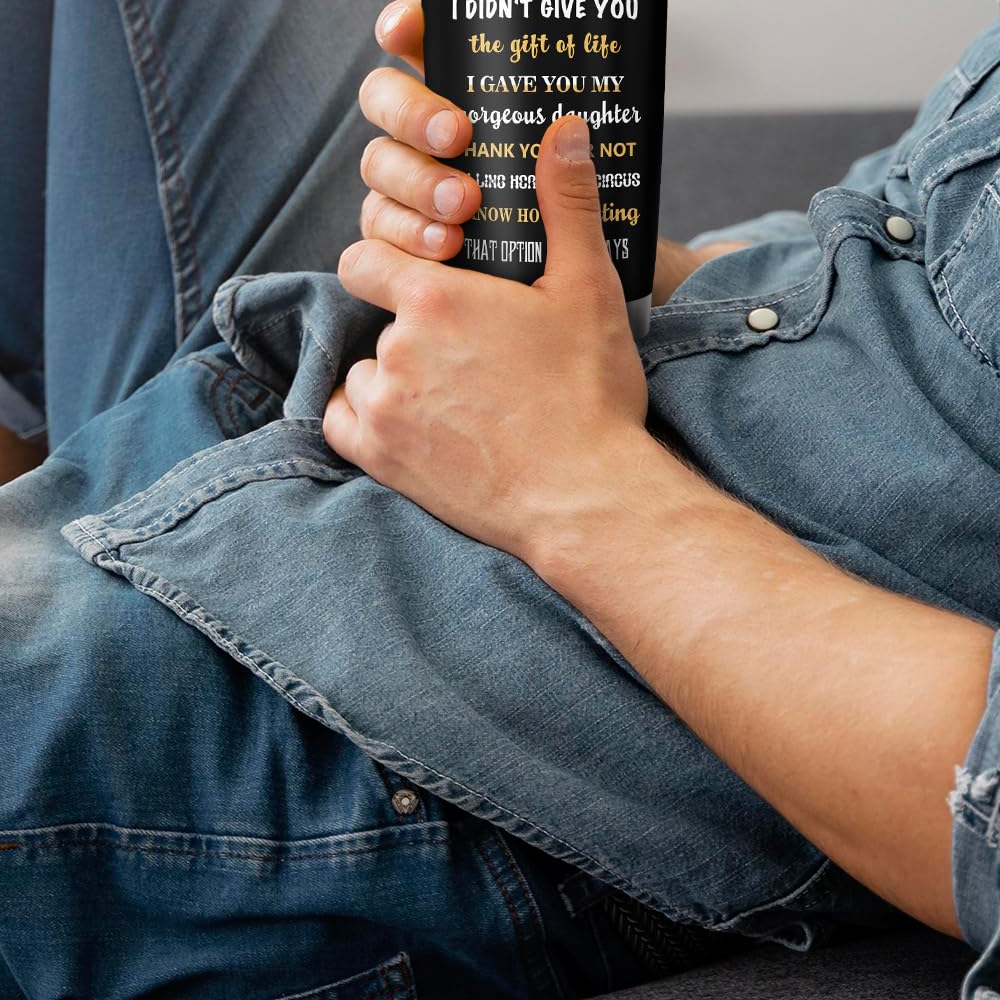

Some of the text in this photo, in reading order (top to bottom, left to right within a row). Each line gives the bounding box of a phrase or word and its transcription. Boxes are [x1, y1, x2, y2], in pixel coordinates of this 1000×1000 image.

[452, 0, 458, 20] I
[467, 32, 621, 64] the gift of life
[466, 74, 625, 93] I GAVE YOU MY
[464, 101, 641, 130] orgeous dughter
[463, 141, 515, 159] HANK
[520, 143, 540, 160] YO
[600, 142, 637, 158] NOT
[472, 206, 513, 223] NOW
[517, 207, 541, 223] HO
[465, 238, 498, 261] THAT
[500, 240, 542, 263] OPTION
